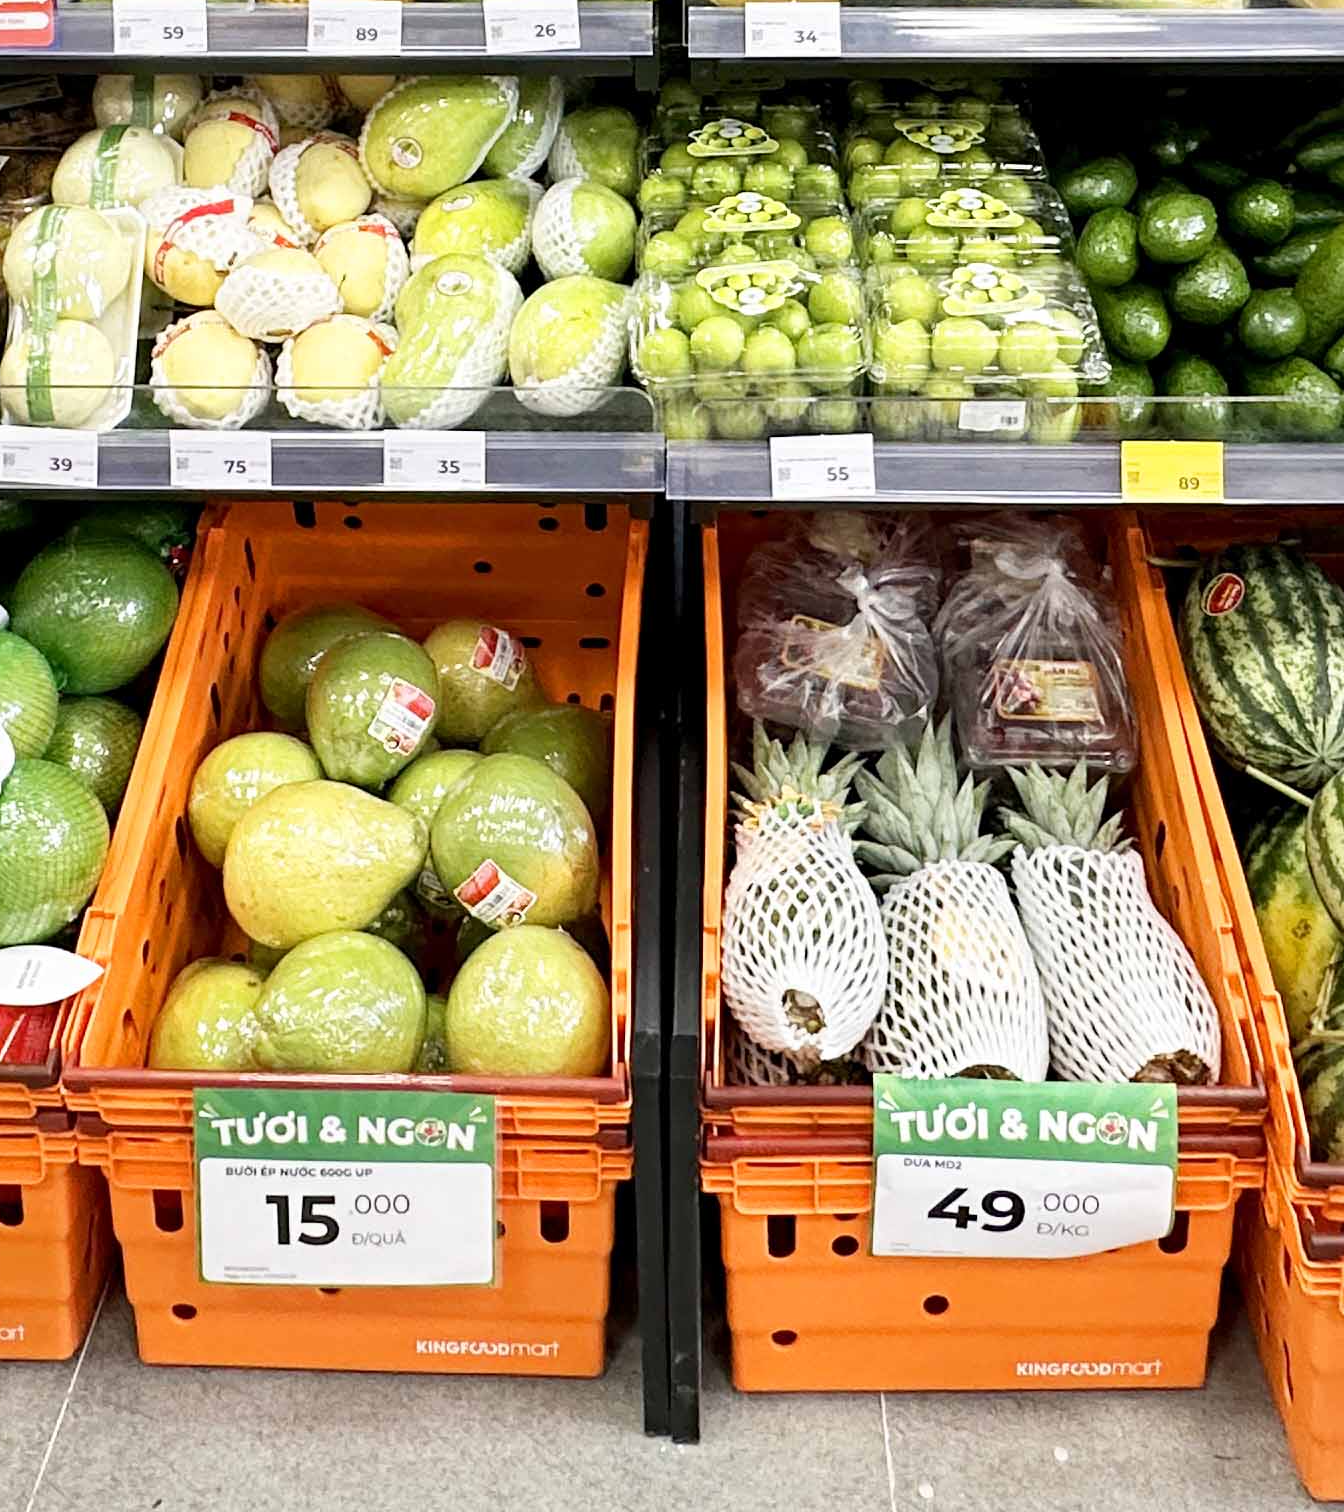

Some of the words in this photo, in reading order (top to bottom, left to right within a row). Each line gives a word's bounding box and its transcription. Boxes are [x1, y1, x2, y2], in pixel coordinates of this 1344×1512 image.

[163, 26, 184, 39] 59
[357, 28, 377, 41] 89
[535, 24, 556, 37] 26
[794, 30, 817, 43] 34
[49, 458, 73, 472] 39
[224, 460, 246, 474] 75
[438, 460, 460, 474] 35
[826, 466, 849, 481] 55
[1178, 476, 1200, 490] 89
[211, 1110, 308, 1146] TƯƠI
[319, 1115, 347, 1144] &
[891, 1102, 988, 1144] TƯƠI
[1000, 1108, 1029, 1141] &
[934, 1159, 962, 1171] MD2
[320, 1167, 352, 1178] 600G
[355, 1167, 373, 1177] UP
[927, 1186, 1026, 1233] 49
[265, 1194, 340, 1246] 15
[349, 1194, 411, 1215] .000
[1036, 1222, 1090, 1238] Đ/KG
[352, 1230, 406, 1247] Đ/QUẢ
[416, 1339, 560, 1358] KINGFOODmart
[1016, 1358, 1163, 1378] KINGFOODmart
